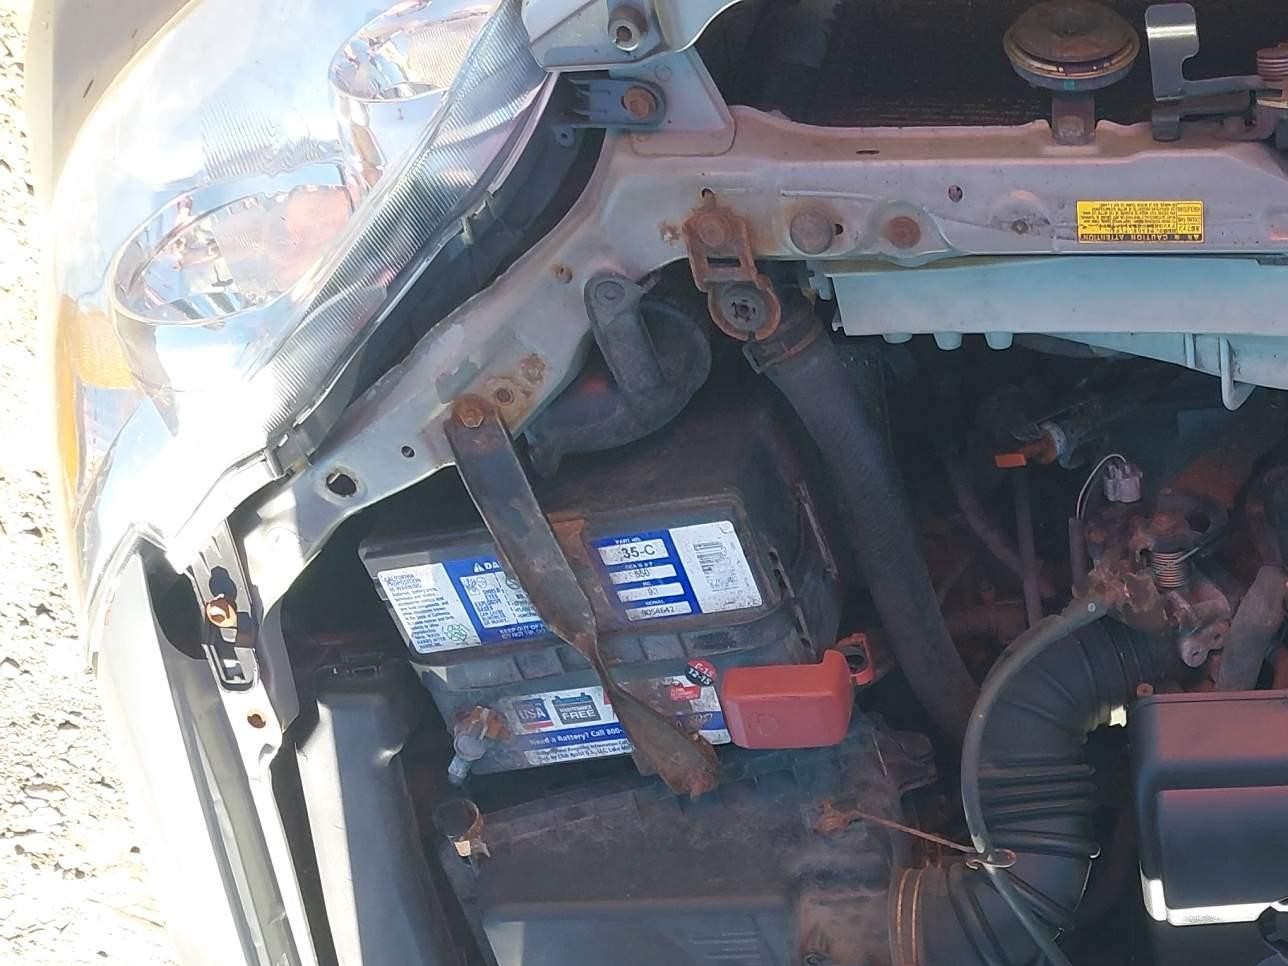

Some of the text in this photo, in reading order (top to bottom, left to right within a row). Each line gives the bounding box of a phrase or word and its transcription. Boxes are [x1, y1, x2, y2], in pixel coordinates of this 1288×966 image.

[621, 544, 656, 559] 35-C
[688, 667, 712, 685] 12-15
[518, 703, 547, 720] USA
[561, 709, 597, 721] FREE
[557, 732, 589, 743] Battery?
[590, 728, 606, 737] Call
